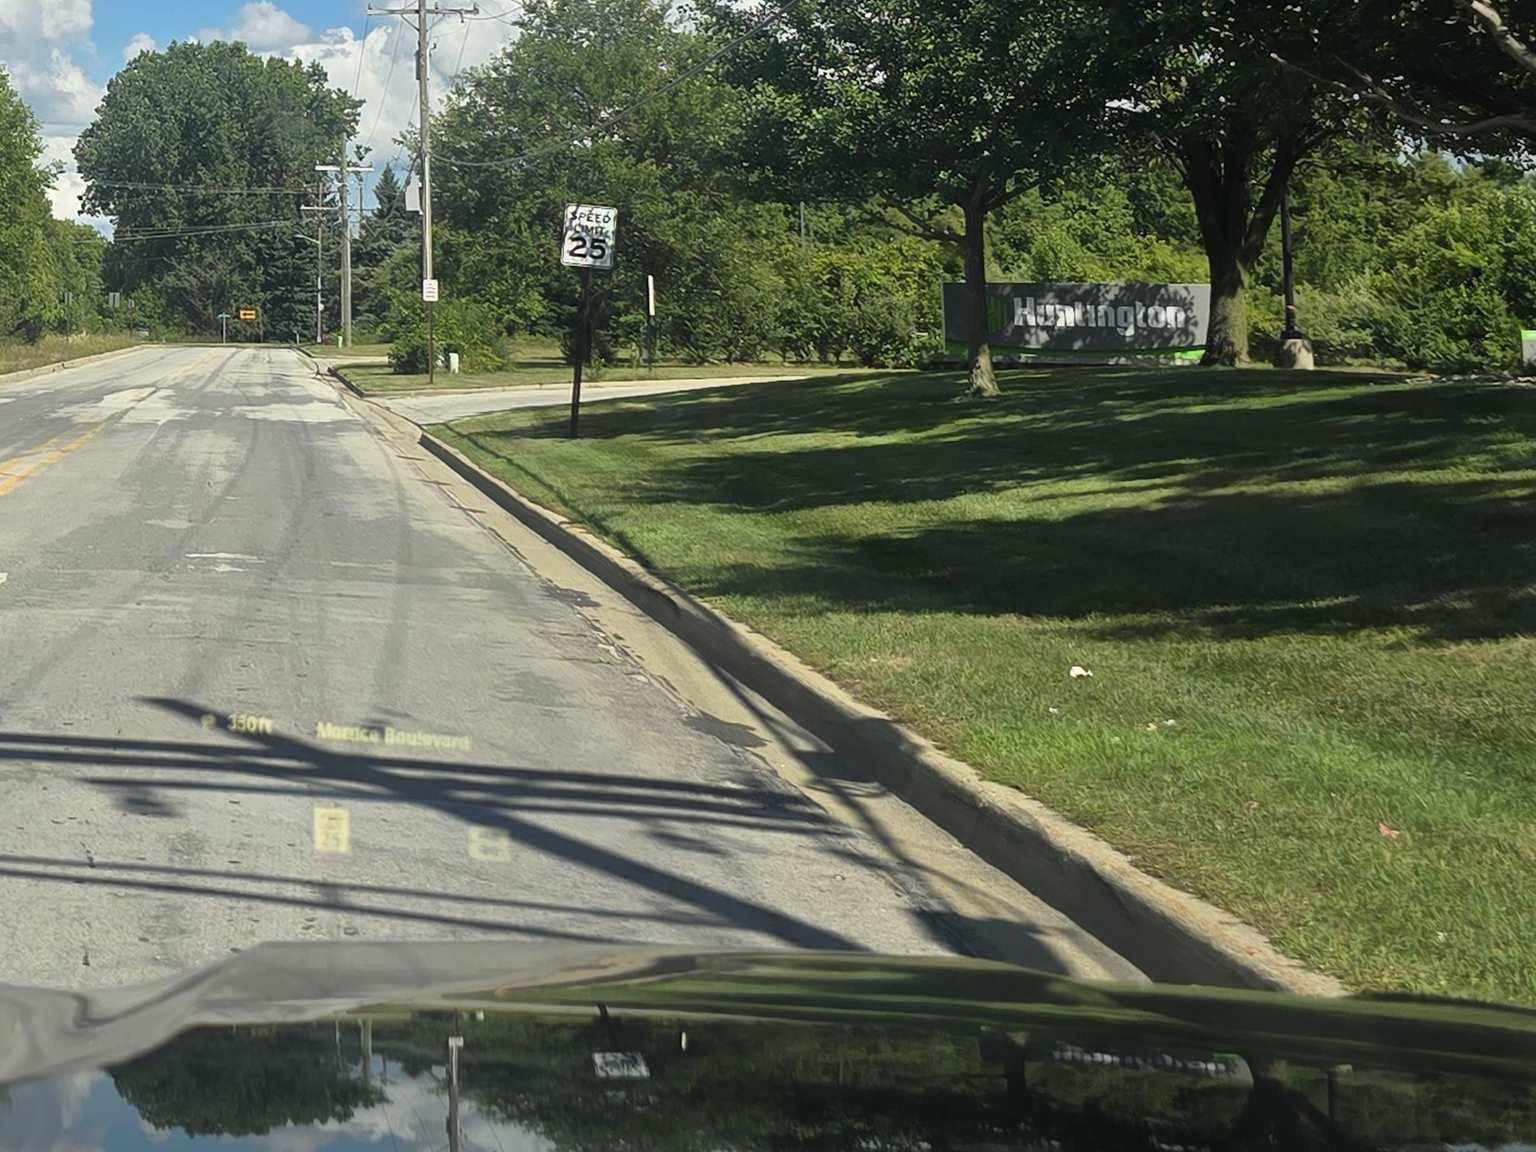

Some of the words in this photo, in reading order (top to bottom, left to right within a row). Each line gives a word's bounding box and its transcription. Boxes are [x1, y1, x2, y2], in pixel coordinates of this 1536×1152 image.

[570, 211, 612, 224] SPEED
[572, 225, 606, 236] LIMIT
[569, 236, 606, 259] 25
[1013, 297, 1187, 337] Huntington
